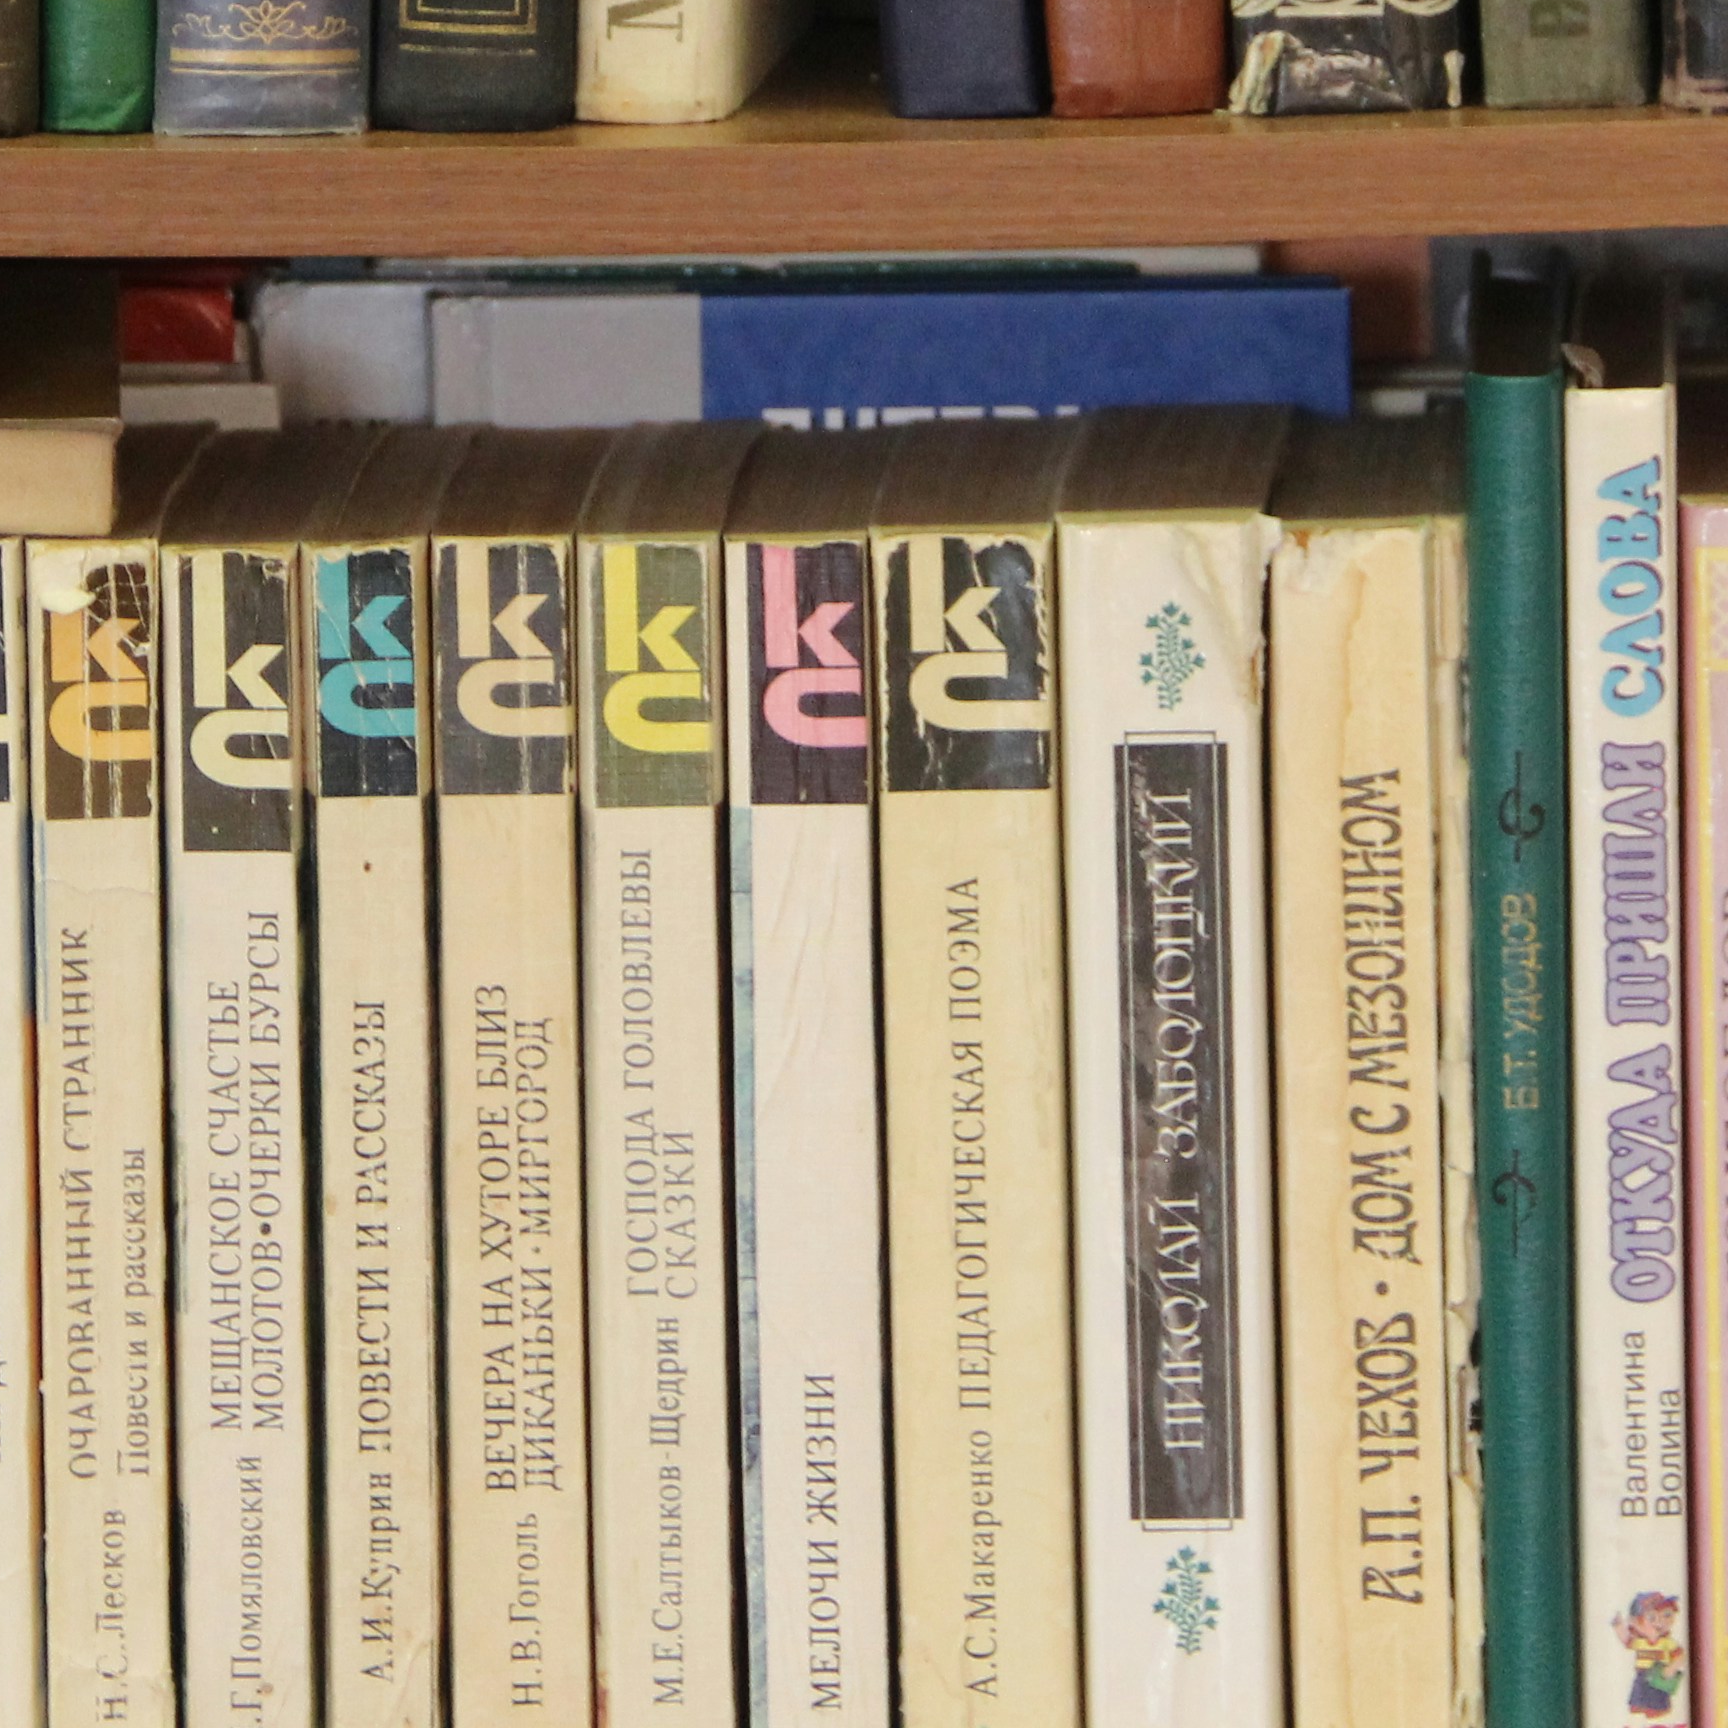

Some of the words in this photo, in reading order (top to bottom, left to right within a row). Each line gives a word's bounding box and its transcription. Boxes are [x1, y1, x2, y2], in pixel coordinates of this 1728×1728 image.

[1597, 454, 1664, 718] СЛОВА
[619, 847, 656, 1091] ГОЛОВЛЕВЫ
[944, 875, 983, 1024] ПОЭМА
[1337, 767, 1410, 1091] МЕЗОНИНОМ
[1501, 891, 1544, 1038] УДОДОВ
[1599, 740, 1672, 1027] ПРИШЛИ
[56, 924, 97, 1153] СТРАННИК
[245, 910, 282, 1046] БУРСЫ
[474, 983, 510, 1089] БЛИЗ
[1139, 786, 1211, 1161] ЗАБОЛОЦКИЙ
[205, 980, 242, 1159] СЧАСТЬЕ
[248, 1061, 284, 1221] ОЧЕРКИ
[351, 999, 390, 1206] РАССКАЗЫ
[513, 1016, 554, 1237] МИРГОРОД
[1348, 1102, 1412, 1136] С
[118, 1147, 154, 1299] рассказы
[354, 1221, 390, 1249] И
[475, 1104, 514, 1262] ХУТОРЕ
[622, 1108, 665, 1299] ГОСПОДА
[662, 1129, 700, 1301] СКАЗКИ
[950, 1039, 996, 1411] ПЕДАГОГИЧЕСКАЯ
[1350, 1146, 1422, 1266] ДОМ
[1604, 1042, 1678, 1304] ОТКУДА
[58, 1168, 100, 1481] ОЧАРОВАННЫЙ
[207, 1170, 247, 1432] МЕЩАНСКОЕ
[248, 1242, 286, 1432] МОЛОТОВ
[355, 1265, 394, 1454] ПОВЕСТИ
[479, 1274, 516, 1328] НА
[519, 1264, 564, 1492] ДИКАНЬКИ
[1146, 1191, 1209, 1452] НИКОЛАЙ
[115, 1338, 152, 1478] Повести
[482, 1341, 519, 1493] ВЕЧЕРА
[803, 1371, 840, 1526] ЖИЗНИ
[1352, 1310, 1421, 1483] ЧЕХОВ
[1618, 1331, 1648, 1520] Валентина
[1654, 1388, 1684, 1517] Волина
[807, 1538, 843, 1711] МЕЛОЧИ
